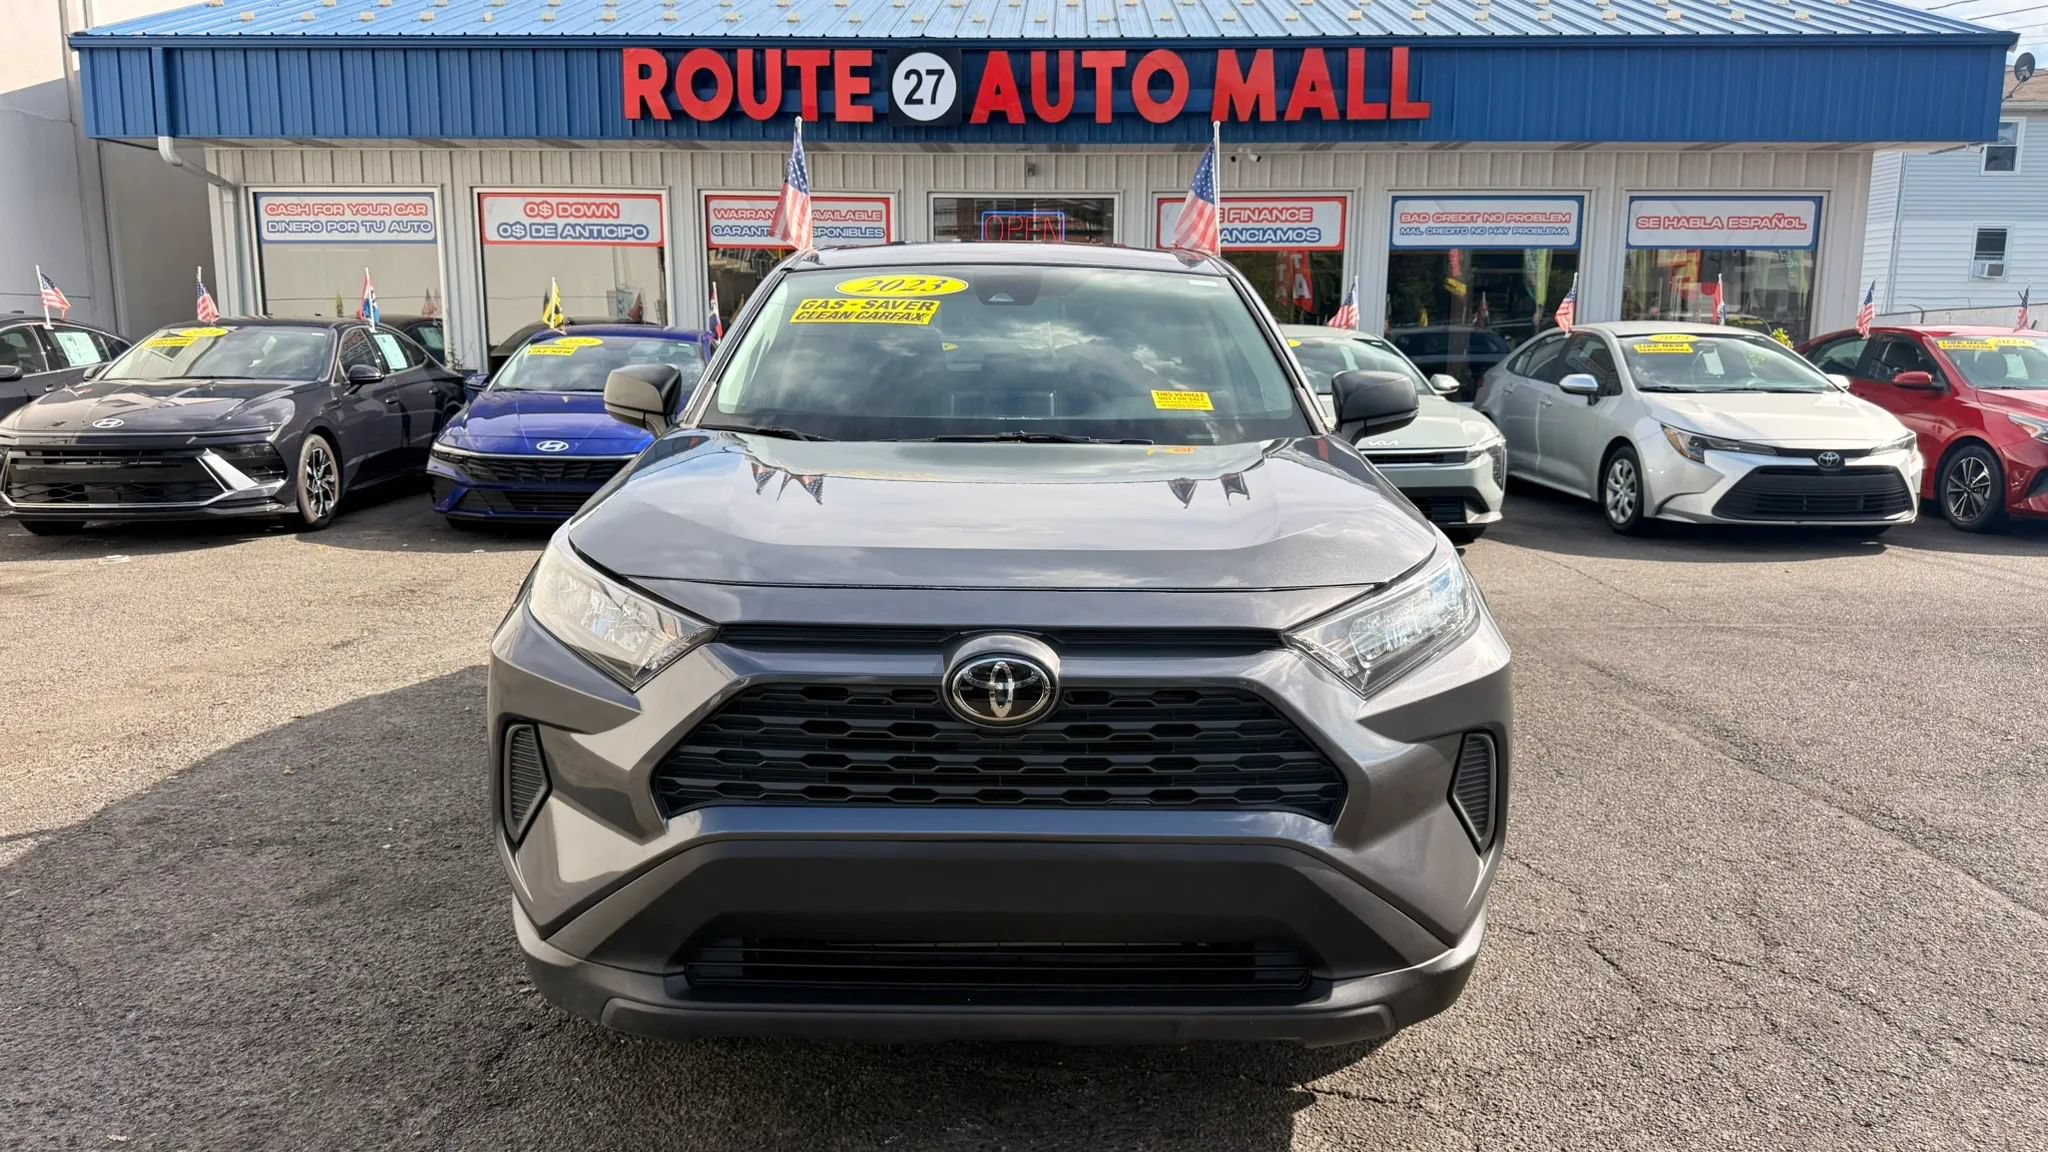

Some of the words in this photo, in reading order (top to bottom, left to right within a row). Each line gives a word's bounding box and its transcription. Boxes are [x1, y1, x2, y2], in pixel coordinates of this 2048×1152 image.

[623, 48, 874, 122] ROUTE
[903, 69, 945, 106] 27
[970, 49, 1190, 124] AUTO
[1211, 47, 1431, 122] MALL
[266, 203, 310, 216] CASH
[313, 203, 344, 216] FOR
[349, 203, 390, 216] YOUR
[394, 203, 427, 216] CAR
[556, 202, 620, 219] DOWN
[714, 208, 777, 220] WARRAN
[811, 209, 882, 221] AVAILABLE
[1227, 207, 1313, 223] FINANCE
[1400, 212, 1430, 223] BAD
[1432, 212, 1481, 223] CREDIT
[1483, 212, 1504, 223] NO
[1506, 212, 1571, 223] PROBLEM
[1636, 216, 1660, 229] SE
[1663, 216, 1723, 229] HABLA
[1727, 213, 1807, 230] ESPAÑOL
[267, 220, 323, 233] DINERO
[326, 220, 359, 233] POR
[362, 221, 384, 233] TU
[388, 221, 432, 233] AUTO
[529, 223, 558, 239] DE
[560, 223, 649, 240] ANTICIPO
[711, 225, 771, 237] GARANT
[985, 214, 1063, 241] OPEN
[1400, 226, 1424, 236] MAL
[1425, 226, 1469, 236] CREDITO
[1470, 226, 1487, 236] NO
[1488, 226, 1511, 236] HAY
[1512, 226, 1569, 236] PROBLEMA
[1220, 227, 1321, 243] ANCIAMOS
[856, 279, 948, 293] 2023
[801, 300, 845, 310] GAS
[861, 300, 934, 311] SAVER
[795, 311, 853, 321] CLEAN
[855, 311, 927, 321] CARFAX
